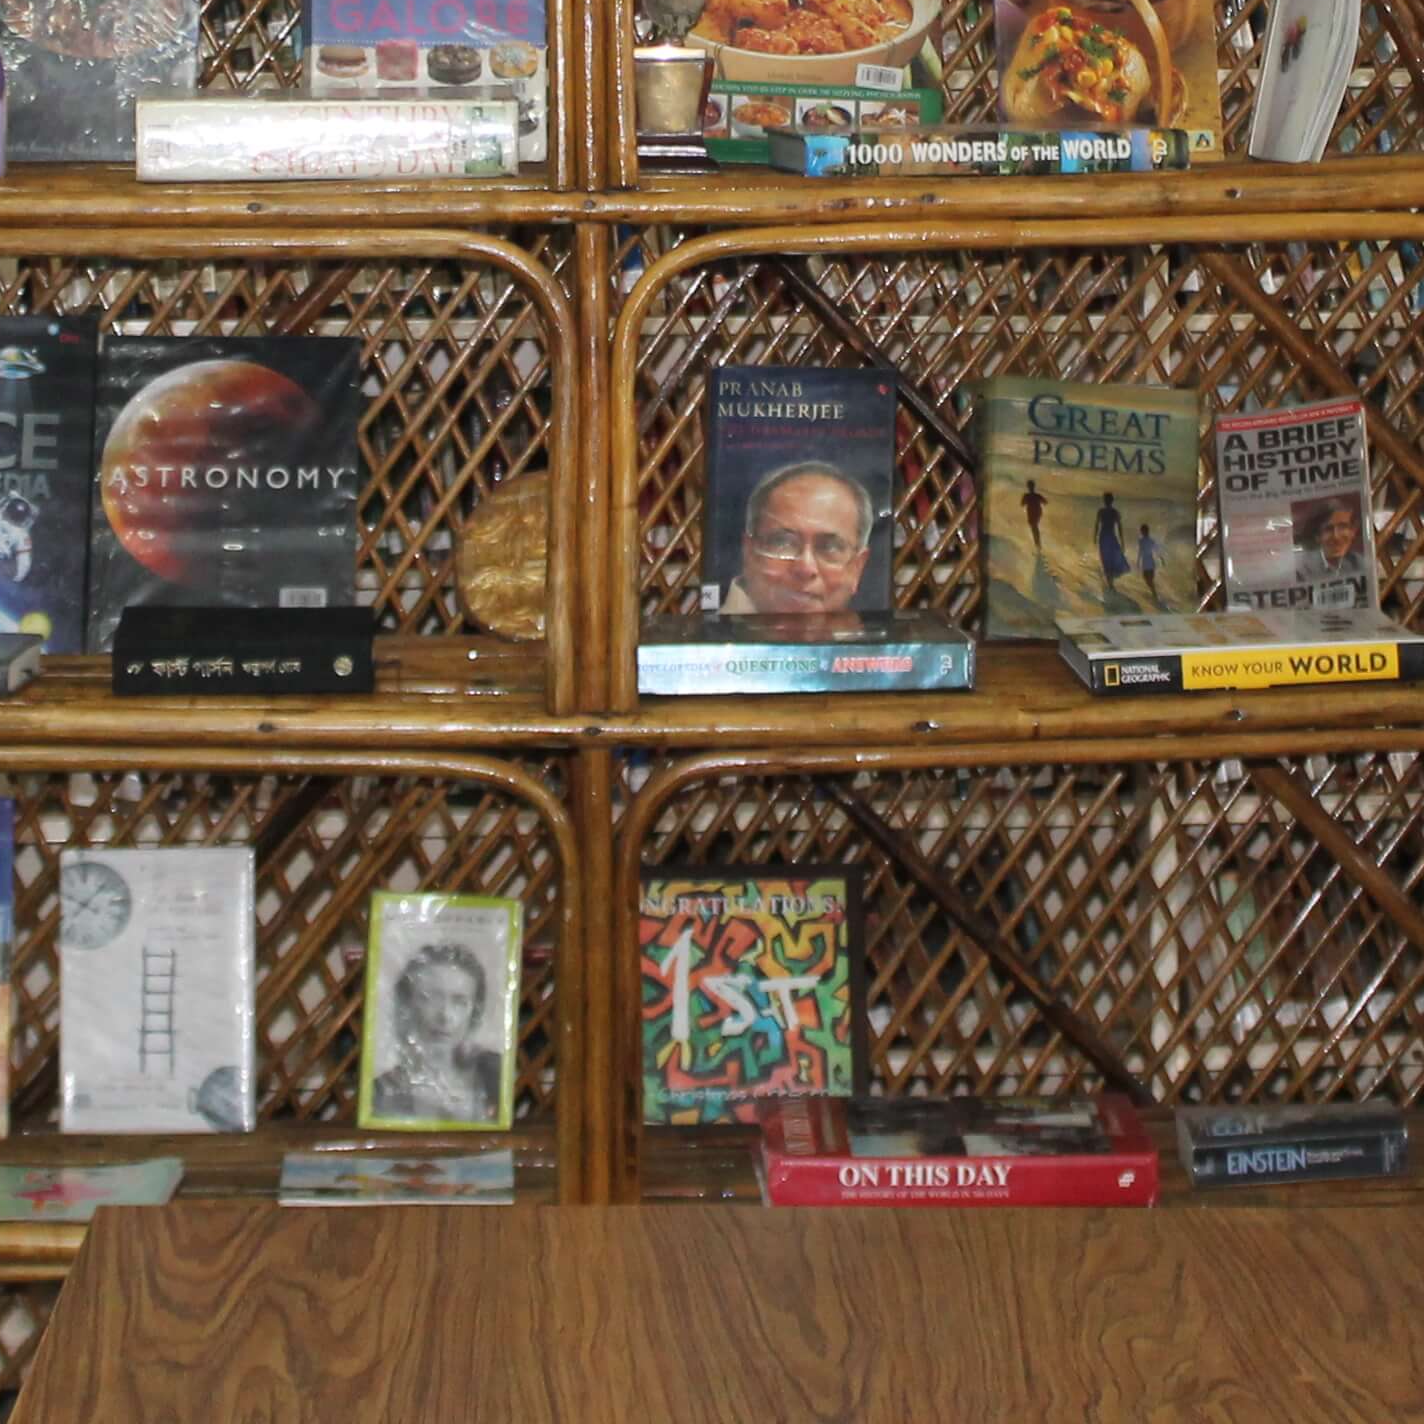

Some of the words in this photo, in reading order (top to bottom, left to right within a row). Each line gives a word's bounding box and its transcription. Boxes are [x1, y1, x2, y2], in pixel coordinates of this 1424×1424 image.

[846, 143, 904, 166] 1000
[910, 140, 1008, 164] WONDERS
[1010, 146, 1030, 161] OF
[1032, 144, 1060, 162] THE
[1062, 138, 1132, 161] WORLD
[718, 380, 804, 398] PRANAB
[717, 402, 846, 423] MUKHERJEE
[1028, 393, 1171, 440] GREAT
[1224, 433, 1249, 453] A
[1257, 416, 1357, 450] BRIEF
[1032, 439, 1167, 475] POEMS
[1223, 437, 1358, 473] HISTORY
[107, 466, 345, 489] ASTRONOMY
[1225, 472, 1269, 493] OF
[1279, 458, 1361, 486] TIME
[1232, 575, 1369, 610] STEPN
[725, 658, 818, 675] QUESTIONS
[1120, 671, 1171, 684] GEOGRAPHIC
[1121, 663, 1161, 674] NATIONAL
[1191, 663, 1239, 678] KNOW
[1243, 662, 1283, 675] YOUR
[1288, 652, 1388, 676] WORLD
[661, 925, 822, 1040] 1ST
[1226, 1146, 1307, 1175] EINSTEIN
[837, 1165, 878, 1188] ON
[884, 1165, 951, 1188] THIS
[955, 1165, 1013, 1188] DAY
